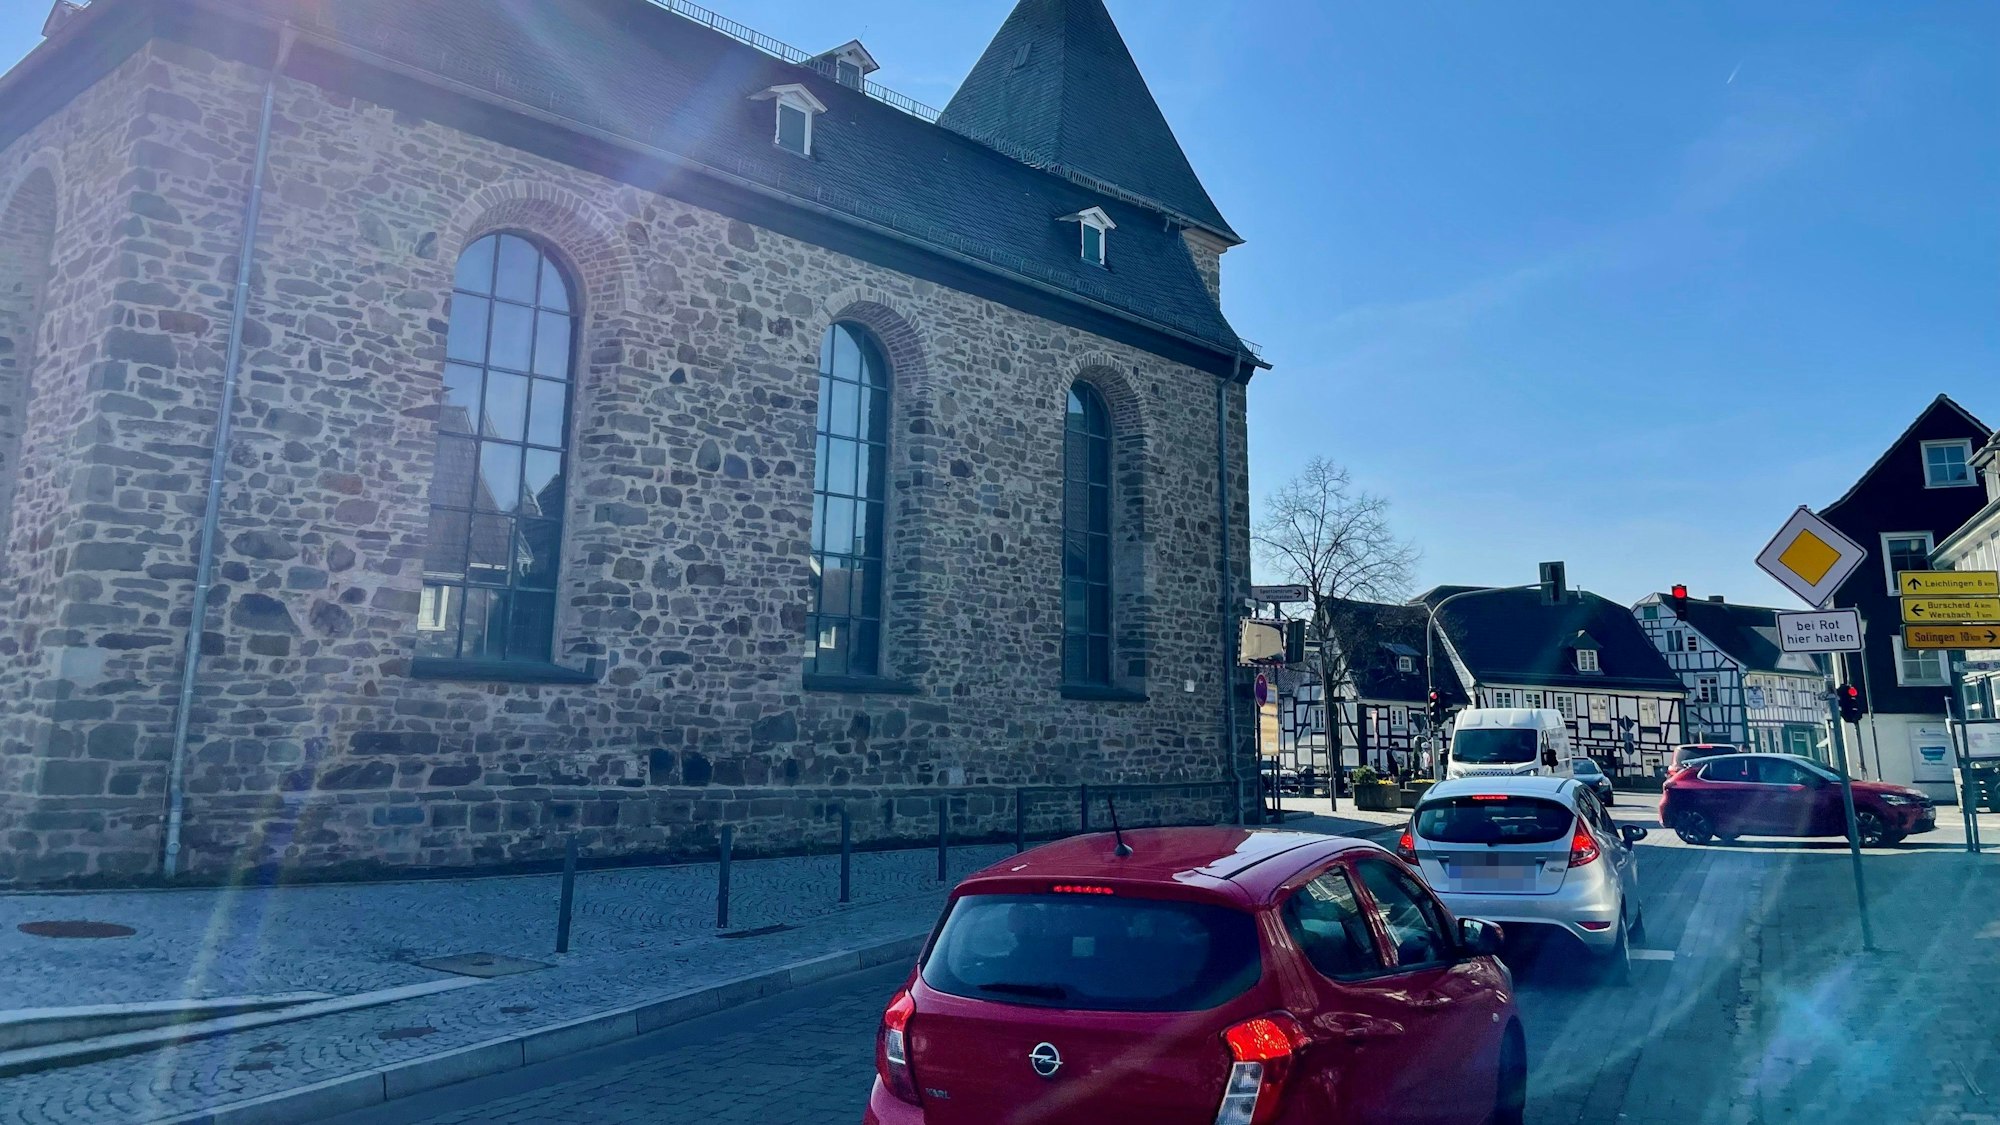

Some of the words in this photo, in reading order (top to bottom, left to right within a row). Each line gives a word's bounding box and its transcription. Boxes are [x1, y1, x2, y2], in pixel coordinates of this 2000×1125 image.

[1925, 580, 1974, 588] Leichlingen
[1927, 601, 1970, 609] Burscheid
[1796, 620, 1815, 631] bei
[1819, 619, 1840, 630] Rot
[1787, 633, 1811, 644] hier
[1815, 632, 1854, 643] halten
[1914, 631, 1955, 643] Solingen
